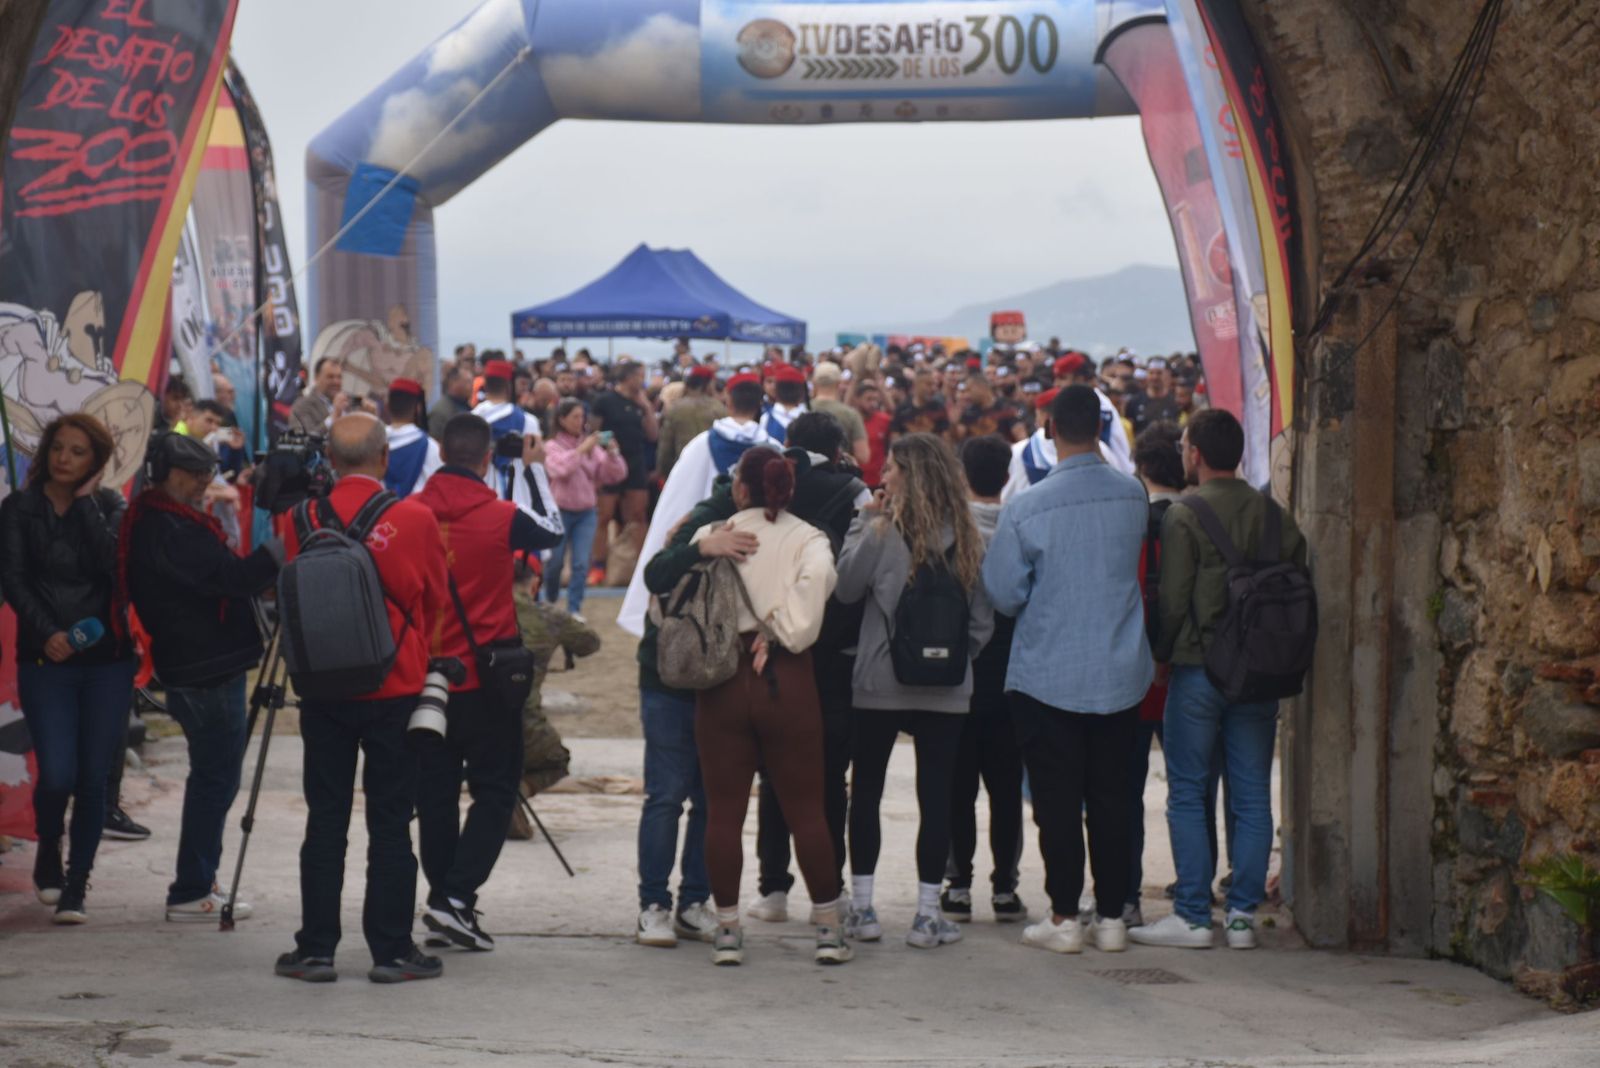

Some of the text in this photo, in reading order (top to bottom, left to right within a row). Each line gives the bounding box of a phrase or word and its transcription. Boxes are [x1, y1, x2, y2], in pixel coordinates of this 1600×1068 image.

[100, 0, 156, 27] EL
[963, 13, 1059, 75] 300
[903, 56, 961, 79] DE LOS
[34, 68, 175, 129] DE LOS
